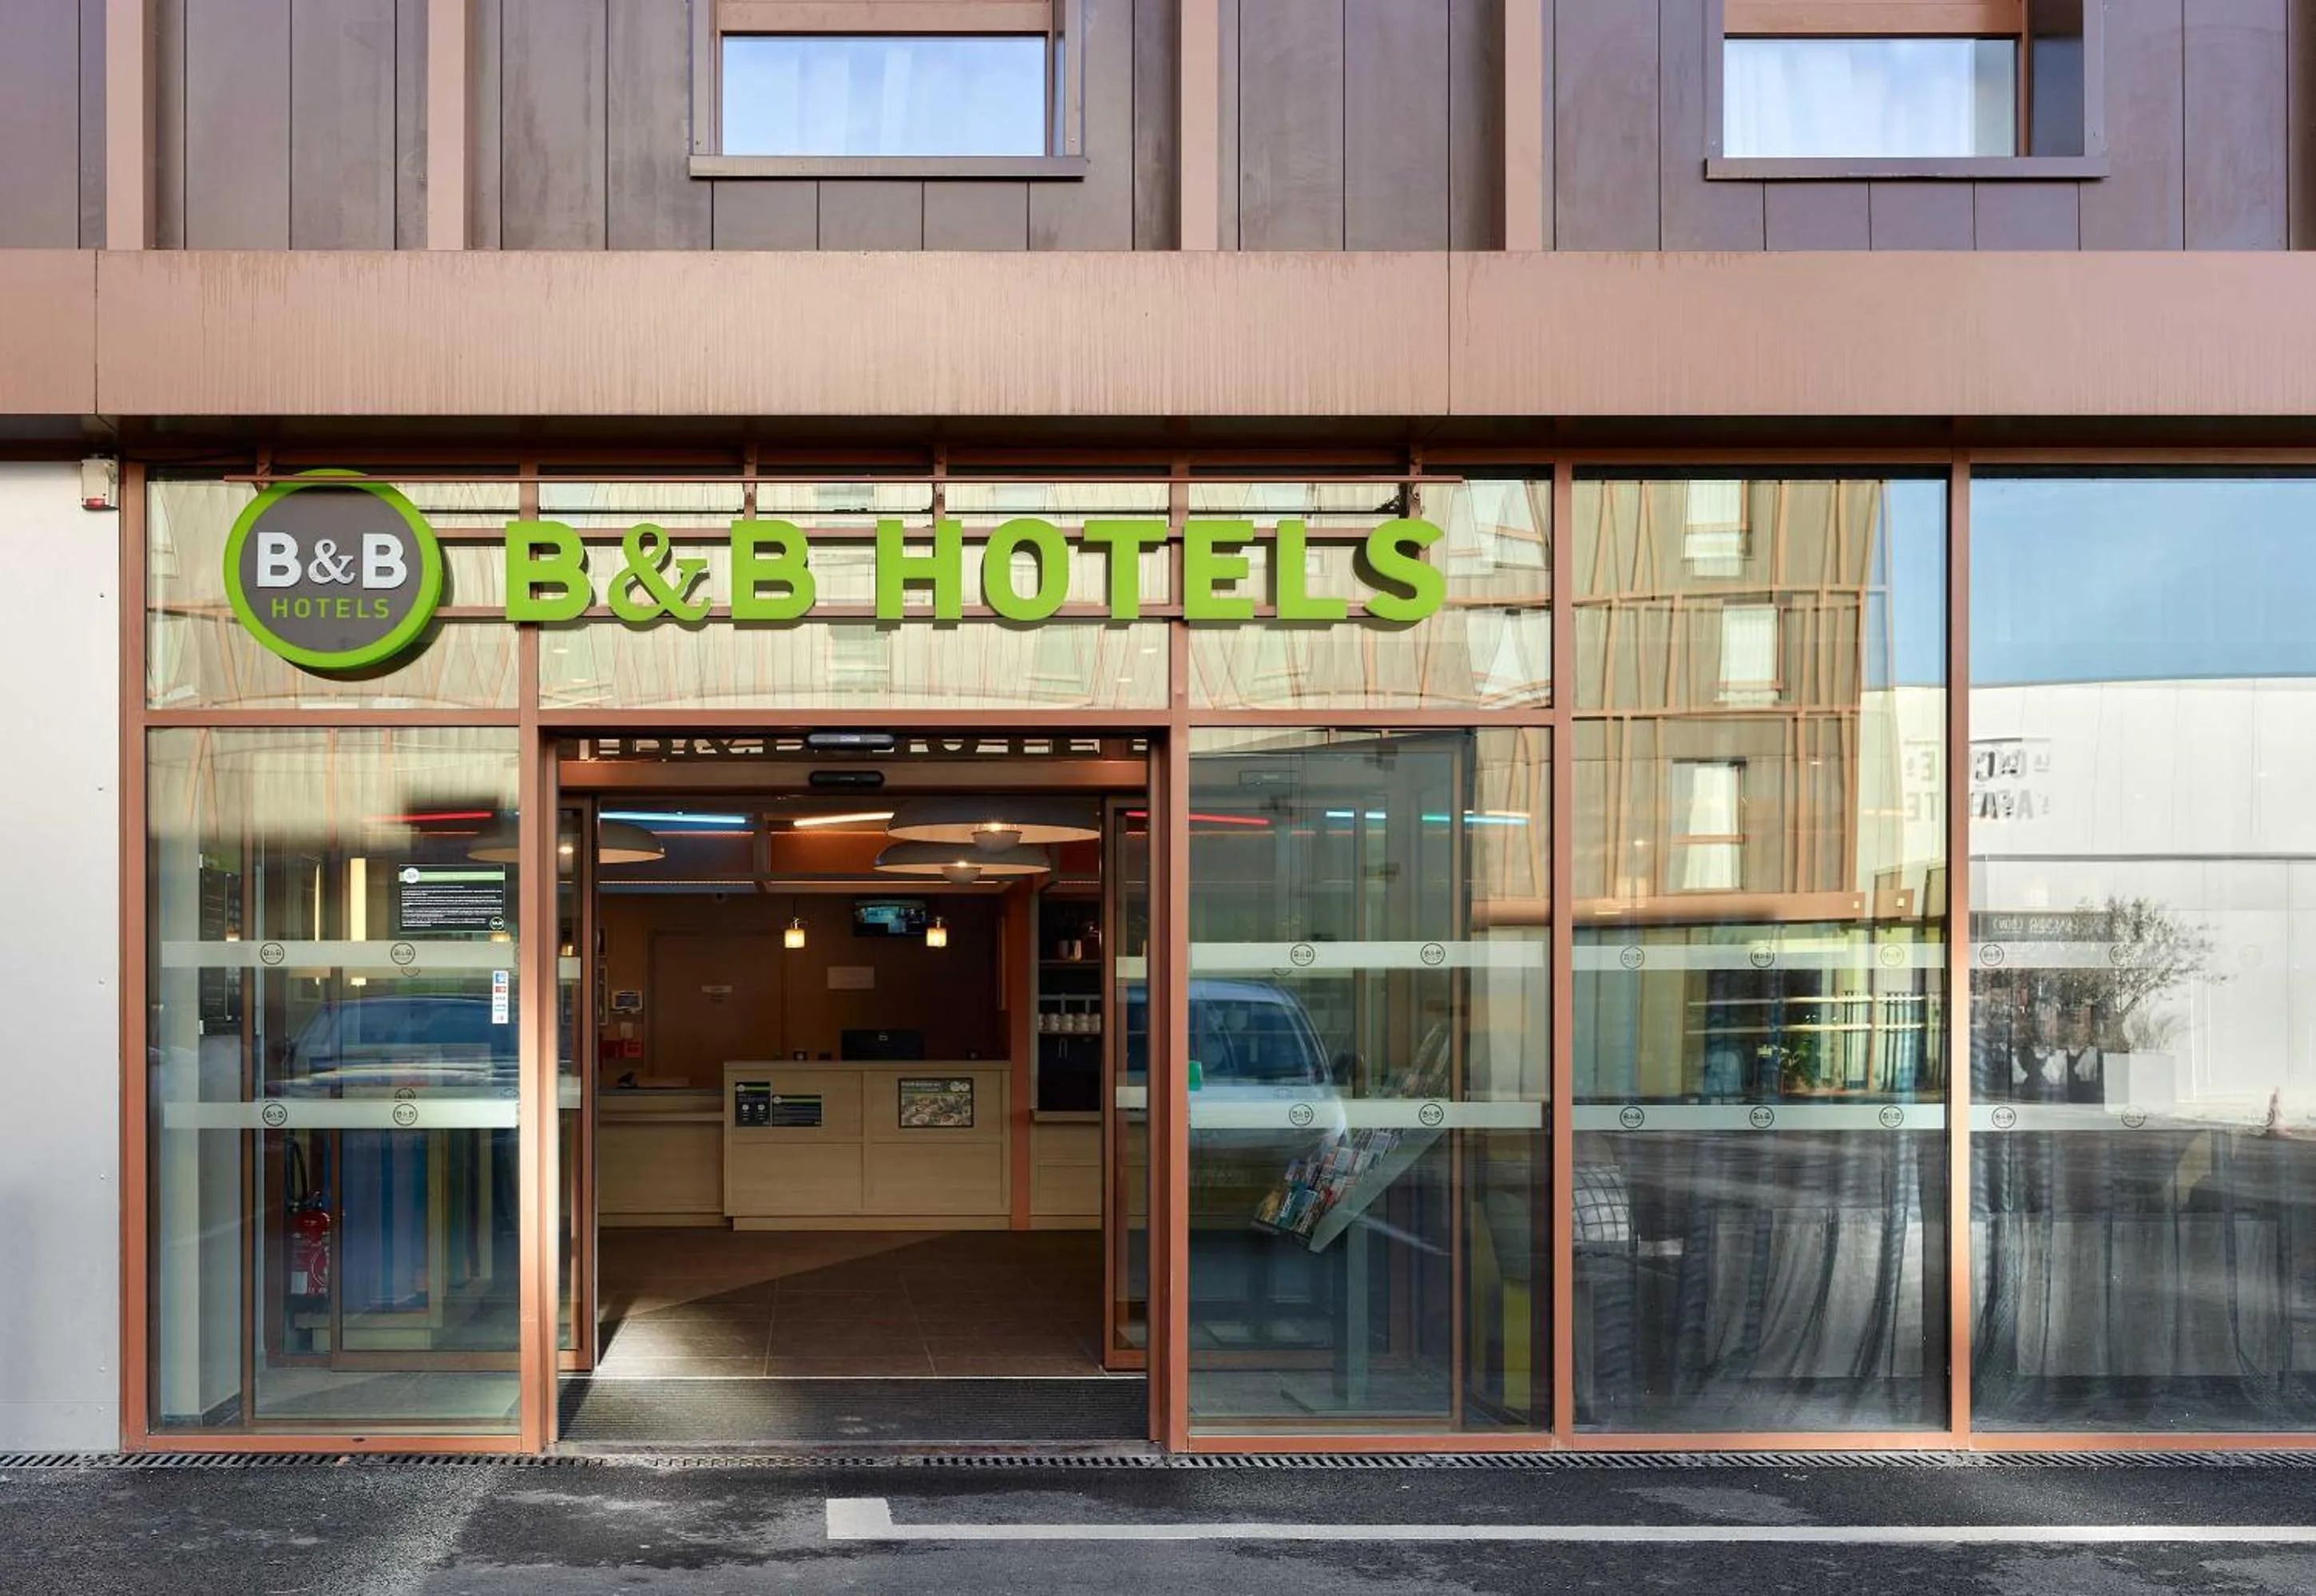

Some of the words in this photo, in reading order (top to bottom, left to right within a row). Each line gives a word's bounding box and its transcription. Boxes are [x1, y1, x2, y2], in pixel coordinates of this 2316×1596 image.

[257, 532, 407, 589] B&B
[506, 520, 815, 621] B&B
[877, 518, 1447, 621] HOTELS
[271, 598, 391, 620] HOTELS
